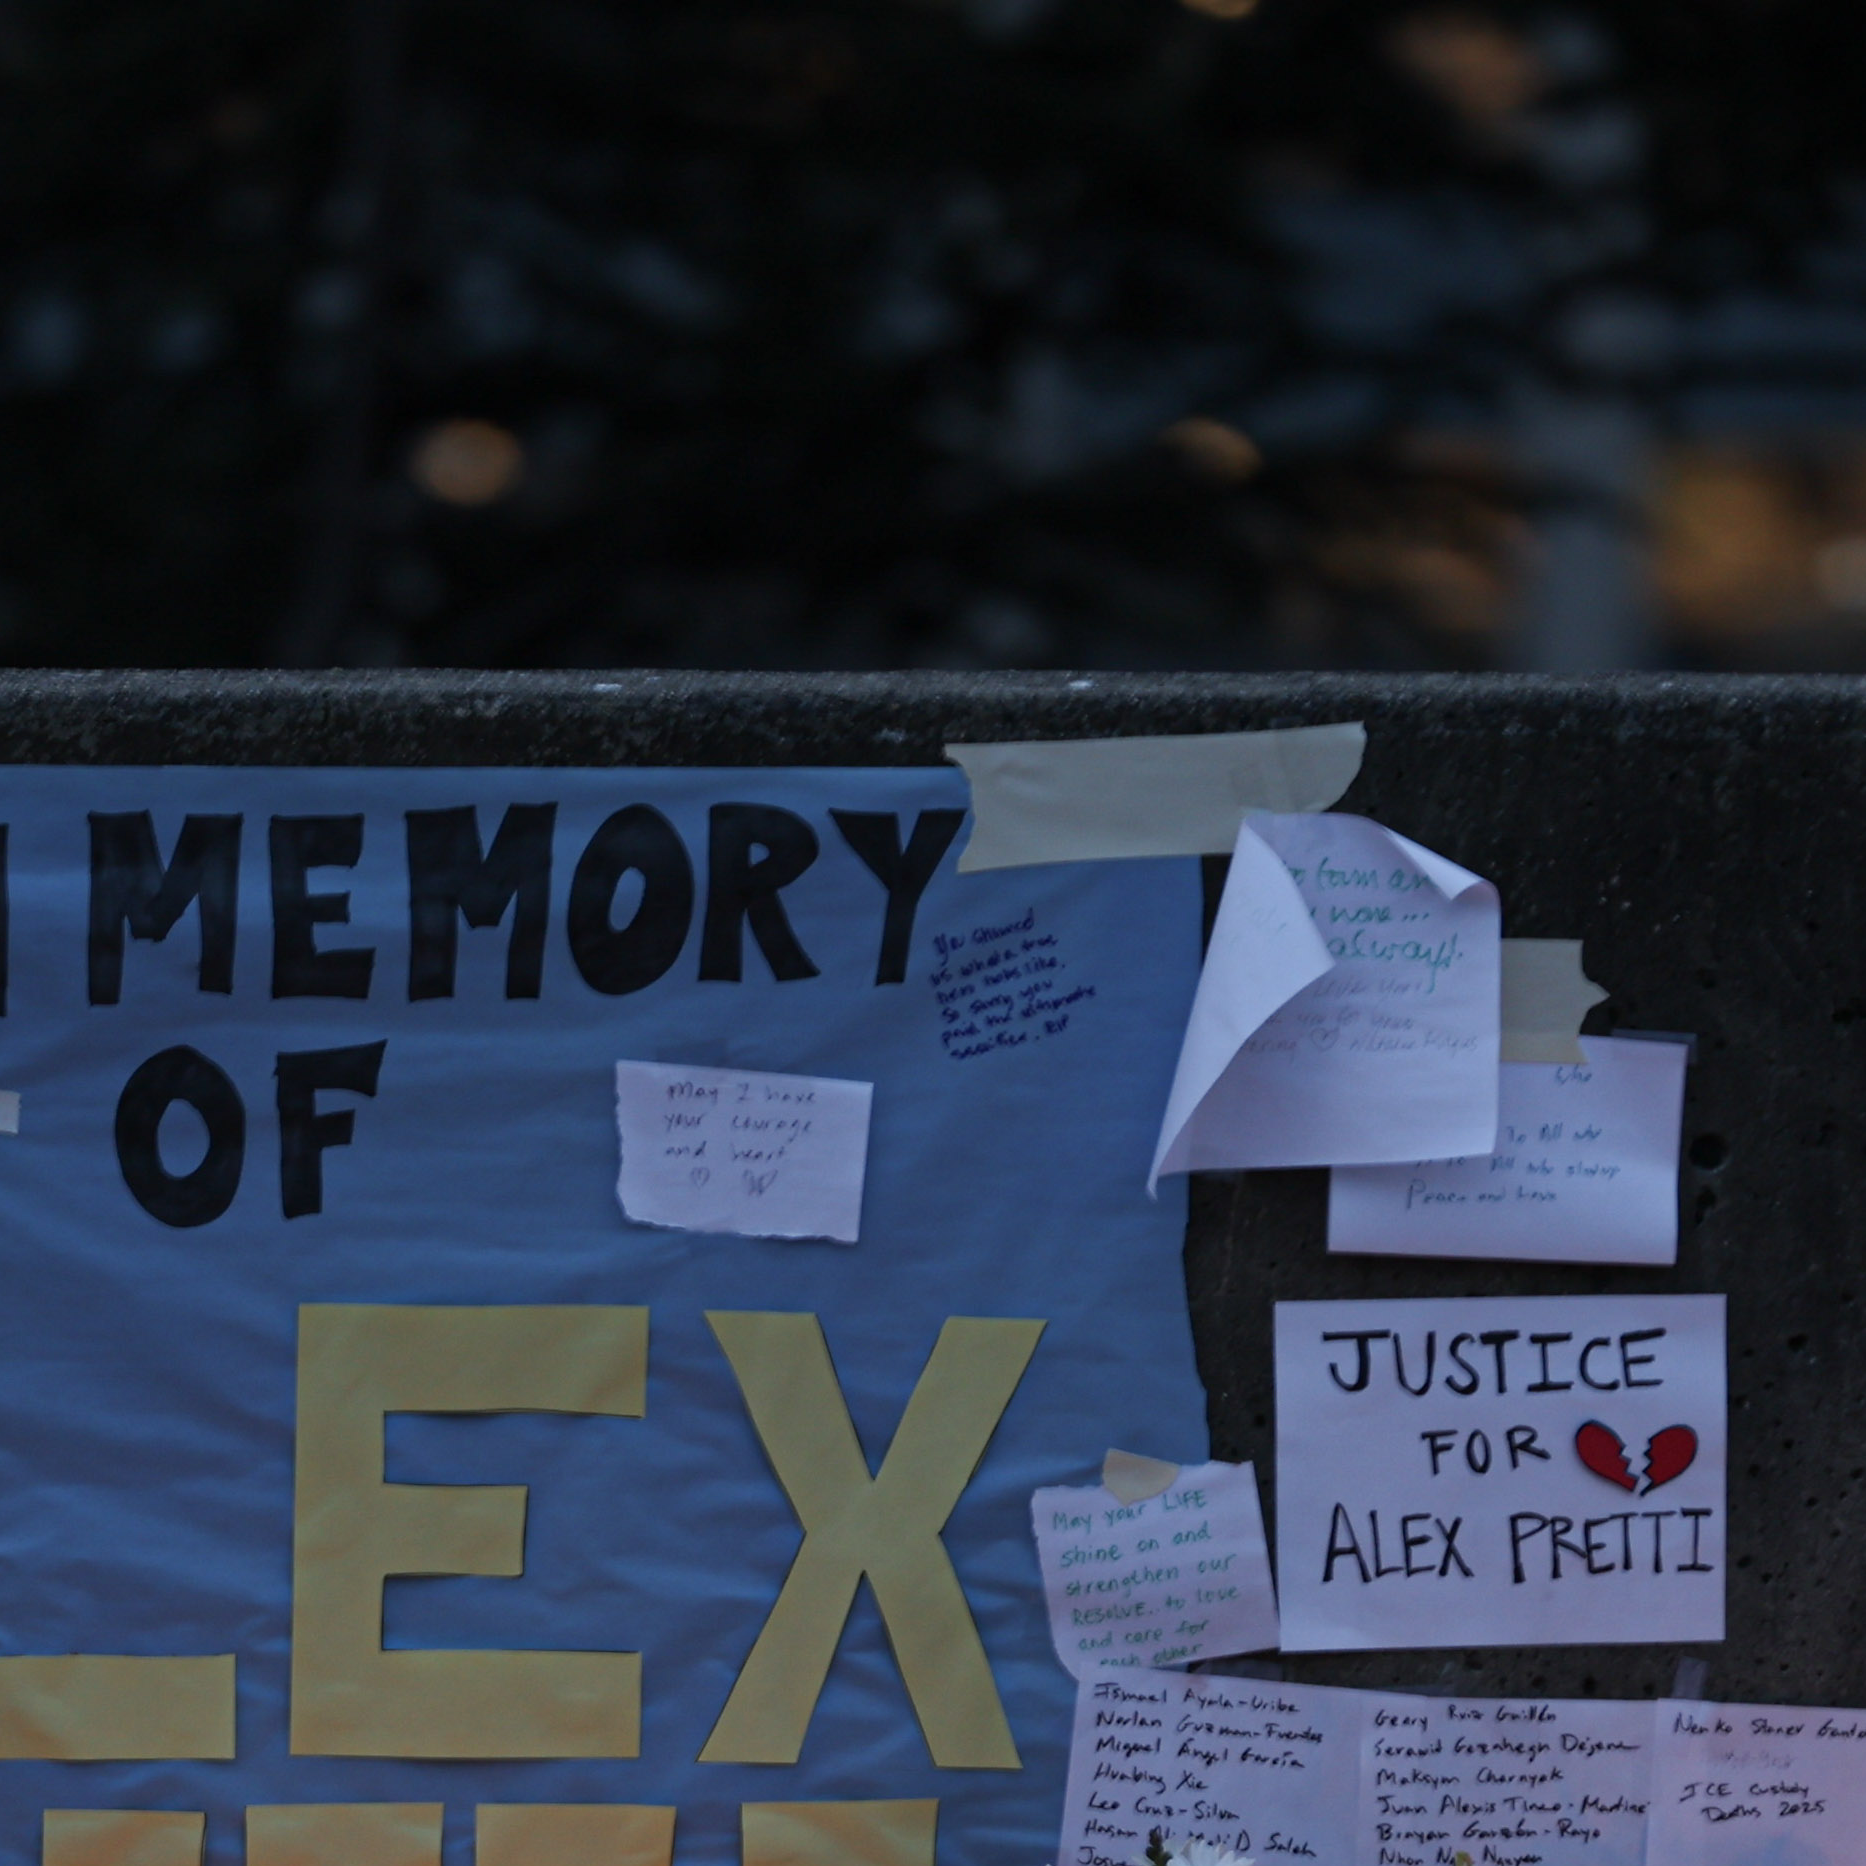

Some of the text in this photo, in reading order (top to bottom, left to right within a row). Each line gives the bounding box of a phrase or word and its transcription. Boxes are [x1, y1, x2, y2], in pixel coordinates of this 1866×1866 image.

[87, 801, 970, 1007] MEMORY
[668, 1082, 719, 1101] May
[765, 1085, 816, 1102] have
[114, 1040, 388, 1227] OF
[664, 1114, 812, 1142] your courage
[665, 1140, 707, 1157] and
[1321, 1327, 1666, 1396] JUSTICE
[1421, 1425, 1551, 1475] FOR
[1052, 1490, 1209, 1534] May your LIFE
[1061, 1521, 1212, 1567] shine on and
[1322, 1502, 1714, 1584] ALEX PRETTI
[1065, 1553, 1238, 1598] strengthen our
[1165, 1586, 1238, 1609] to love
[1078, 1619, 1209, 1650] and care for
[1100, 1643, 1204, 1667] each other
[1093, 1682, 1168, 1703] Ismael
[1096, 1710, 1163, 1728] Norlan
[1375, 1709, 1429, 1731] Geary
[1094, 1736, 1161, 1757] Miguel
[1093, 1762, 1209, 1794] Huabing Xie
[1376, 1768, 1460, 1789] Maksym
[1749, 1780, 1810, 1799] Custody
[1087, 1792, 1120, 1811] Leo
[1377, 1794, 1497, 1816] Juan Alexis
[1779, 1800, 1827, 1818] 2025
[1376, 1823, 1451, 1845] Brayan
[1379, 1849, 1424, 1866] Nhon
